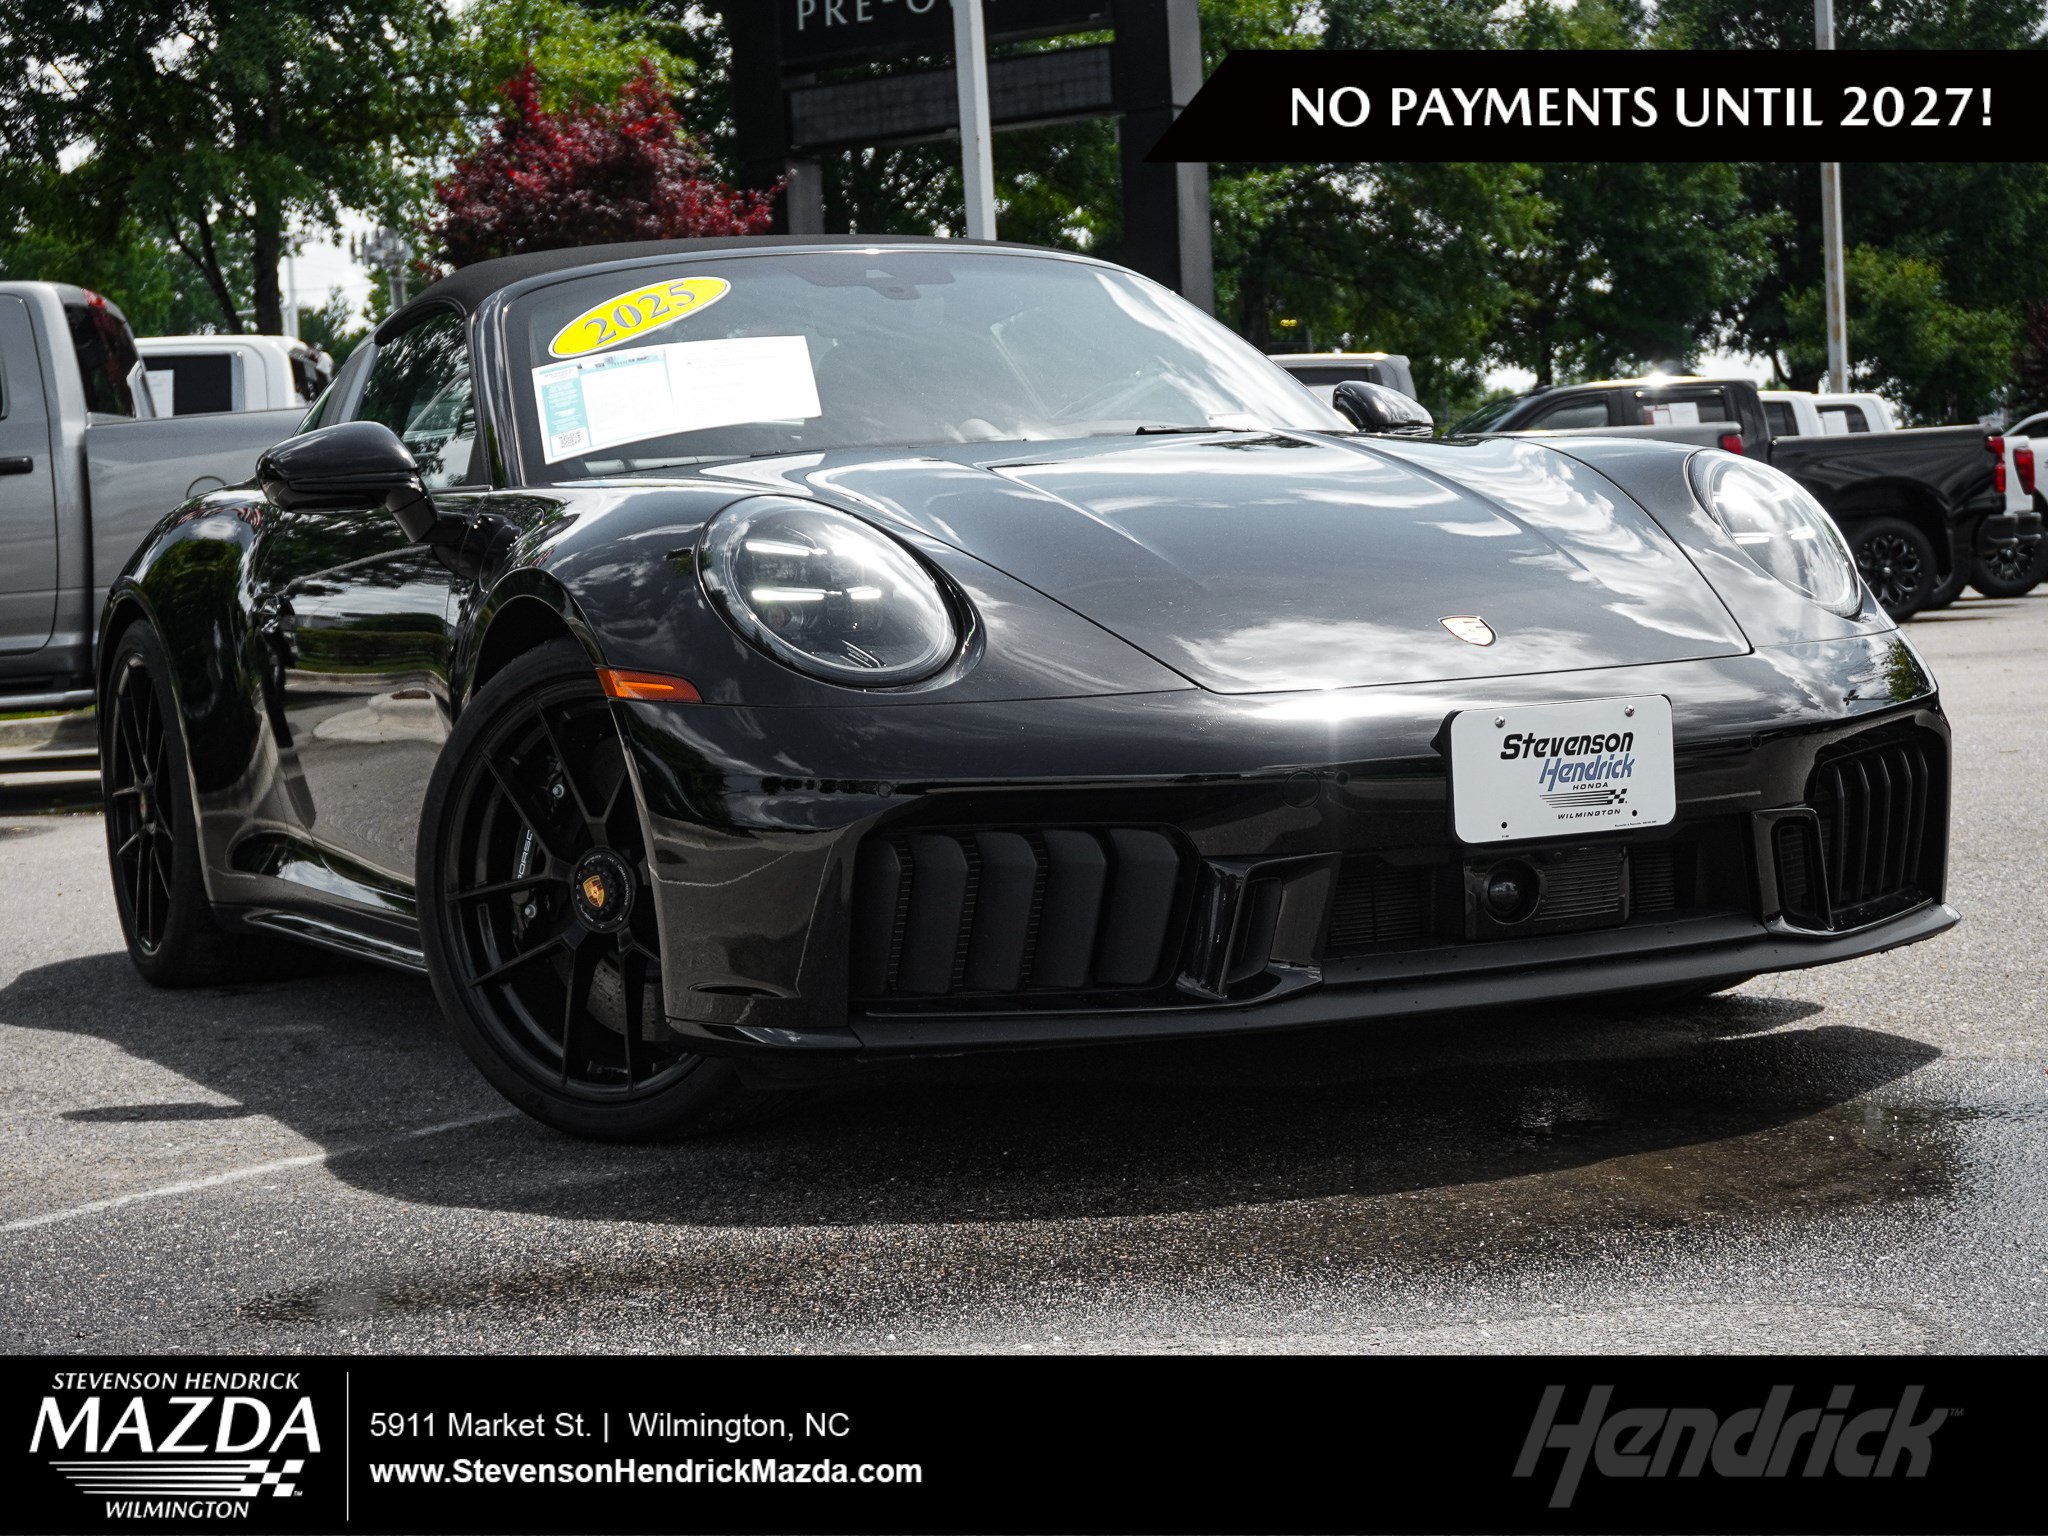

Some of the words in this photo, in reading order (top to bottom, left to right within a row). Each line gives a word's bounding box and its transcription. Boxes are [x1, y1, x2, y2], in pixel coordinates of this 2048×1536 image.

[584, 281, 695, 345] 2025
[1500, 731, 1634, 760] Stevenson
[1538, 752, 1636, 792] Hendrick
[1572, 781, 1609, 791] HONDA
[1557, 808, 1621, 820] WILMINGTON
